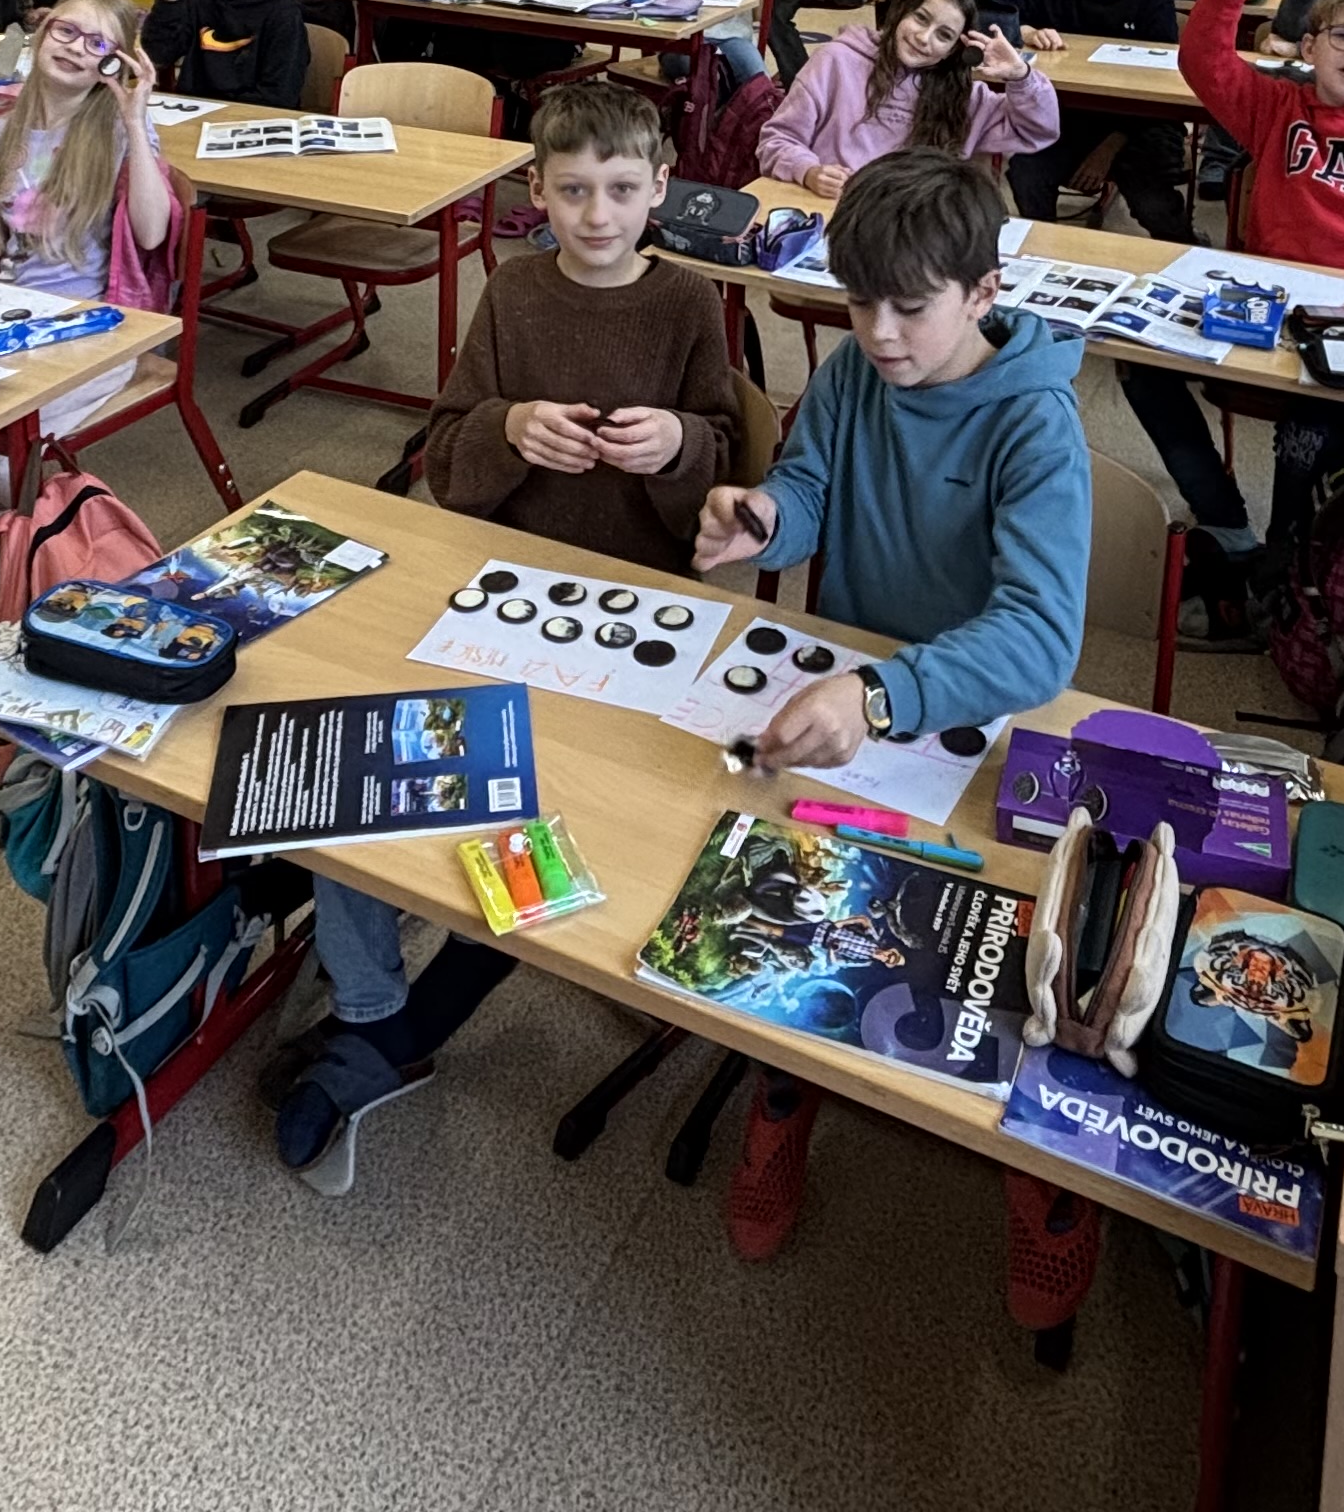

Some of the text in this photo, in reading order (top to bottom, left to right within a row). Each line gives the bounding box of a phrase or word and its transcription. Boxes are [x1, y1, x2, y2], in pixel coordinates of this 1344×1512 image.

[1221, 818, 1271, 836] Galletas
[1223, 809, 1271, 826] rellenas
[944, 890, 989, 994] ČLOVĚK A JEHO SVĚT
[946, 895, 1019, 1062] PŘÍRODOVĚDA
[1134, 1103, 1176, 1128] SVĚT
[1038, 1083, 1302, 1209] PŘÍRODOVĚDA
[1177, 1120, 1222, 1148] JEHO
[1224, 1137, 1238, 1151] A
